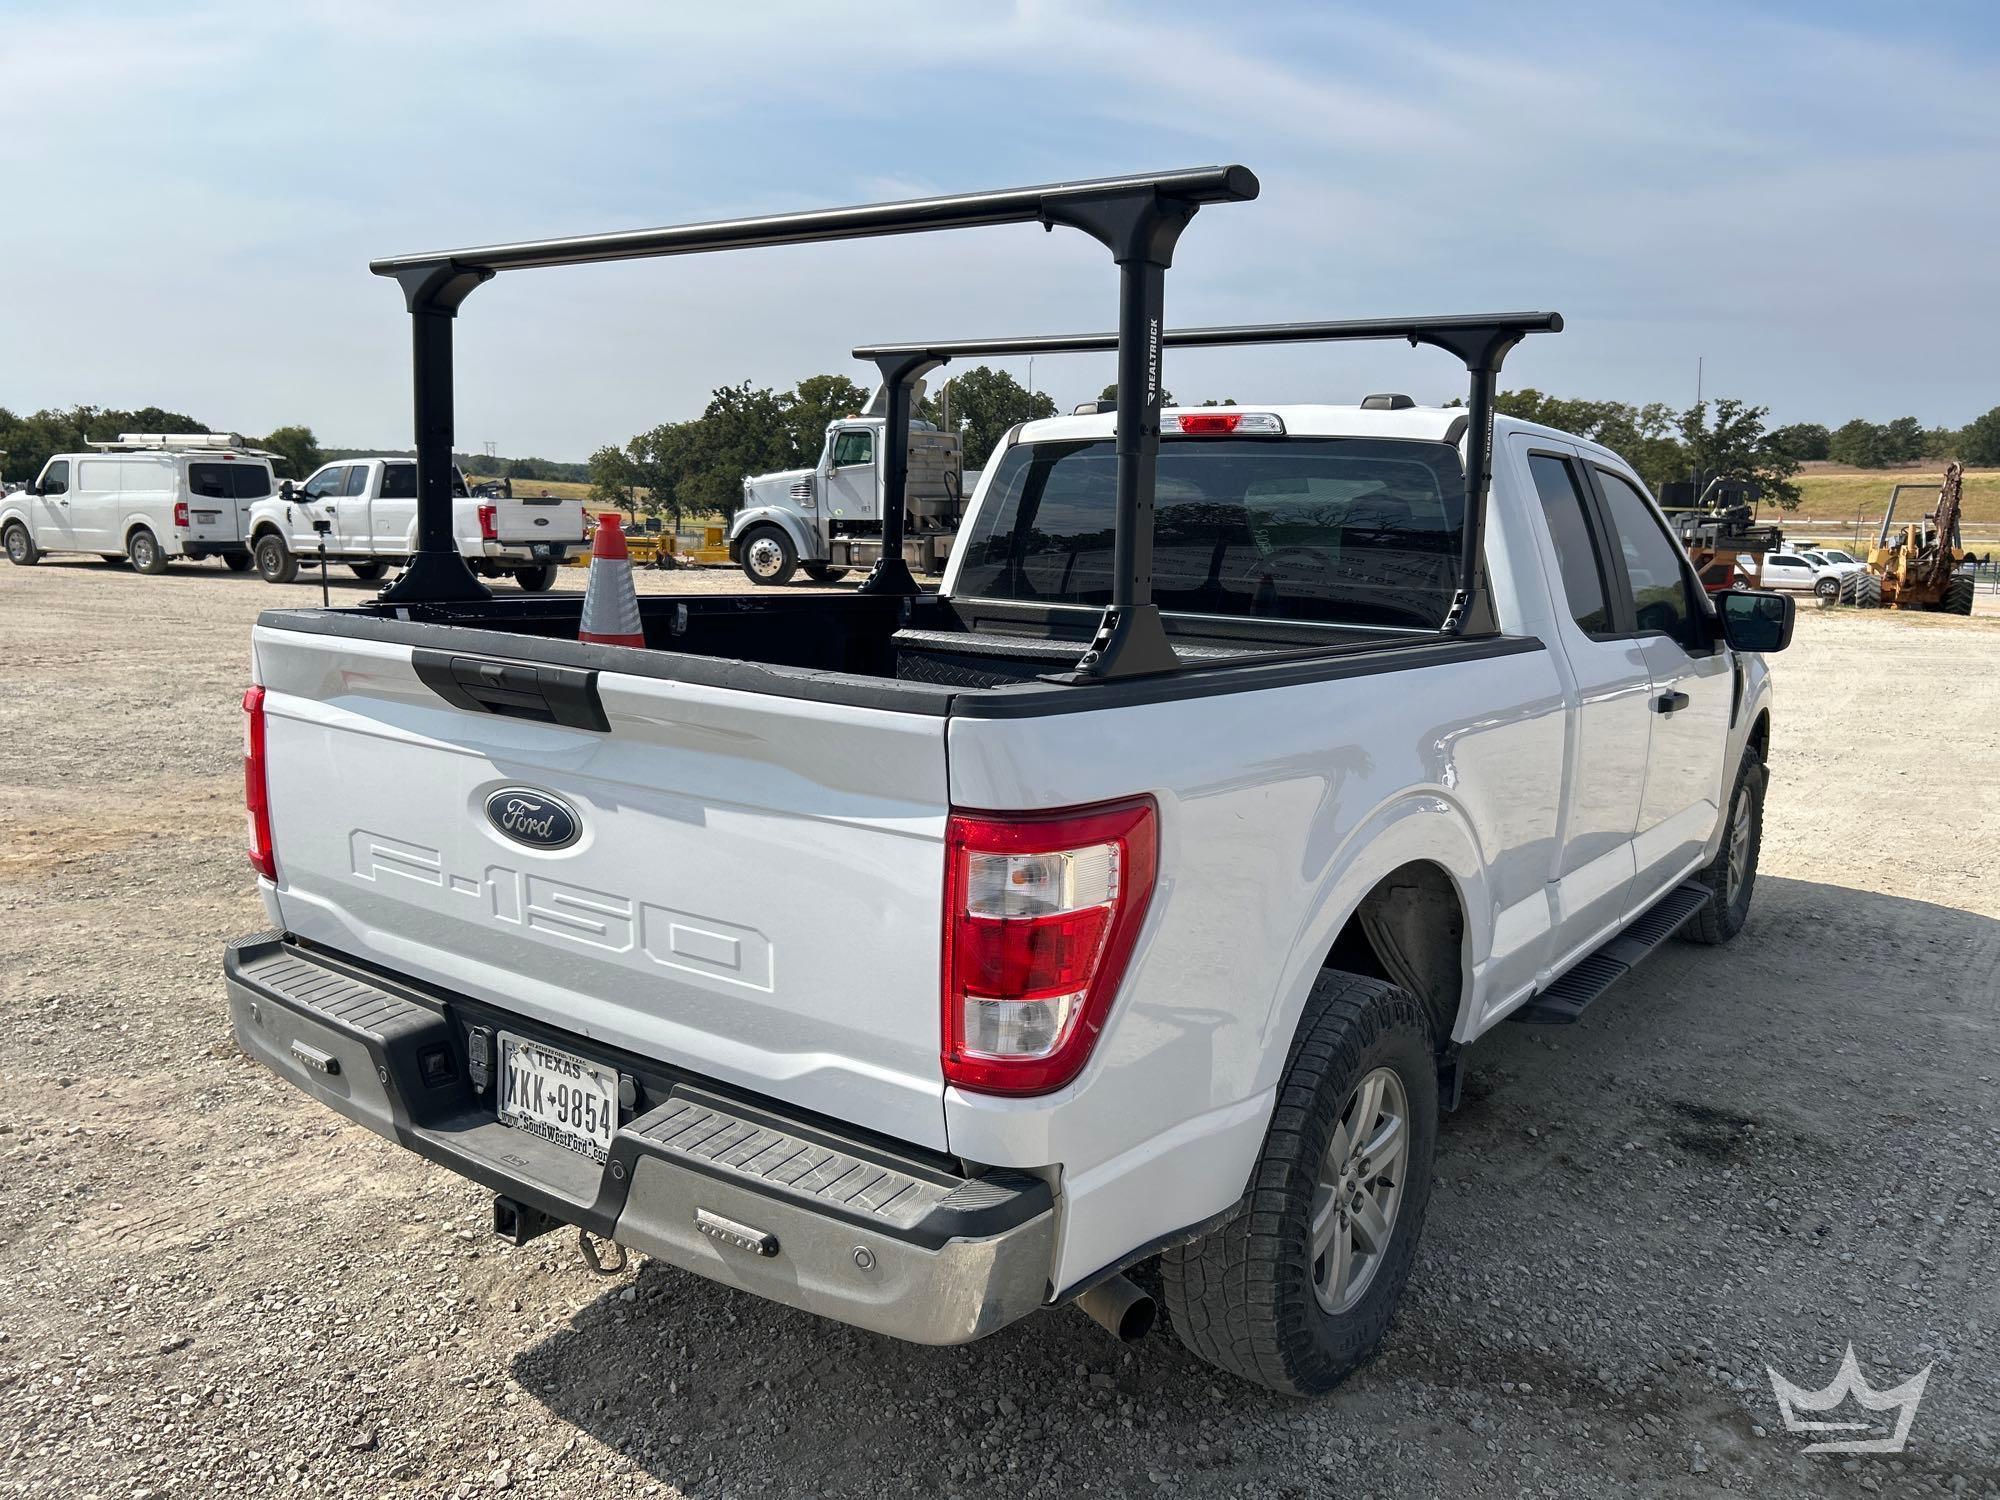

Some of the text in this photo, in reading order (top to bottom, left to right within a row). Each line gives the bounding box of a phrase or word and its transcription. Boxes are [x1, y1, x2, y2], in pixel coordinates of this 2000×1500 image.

[1148, 318, 1158, 391] REALTRUCK
[502, 798, 555, 838] Ford
[348, 828, 774, 993] F-150
[535, 1051, 581, 1080] TEXAS
[507, 1065, 611, 1140] XKK 9854
